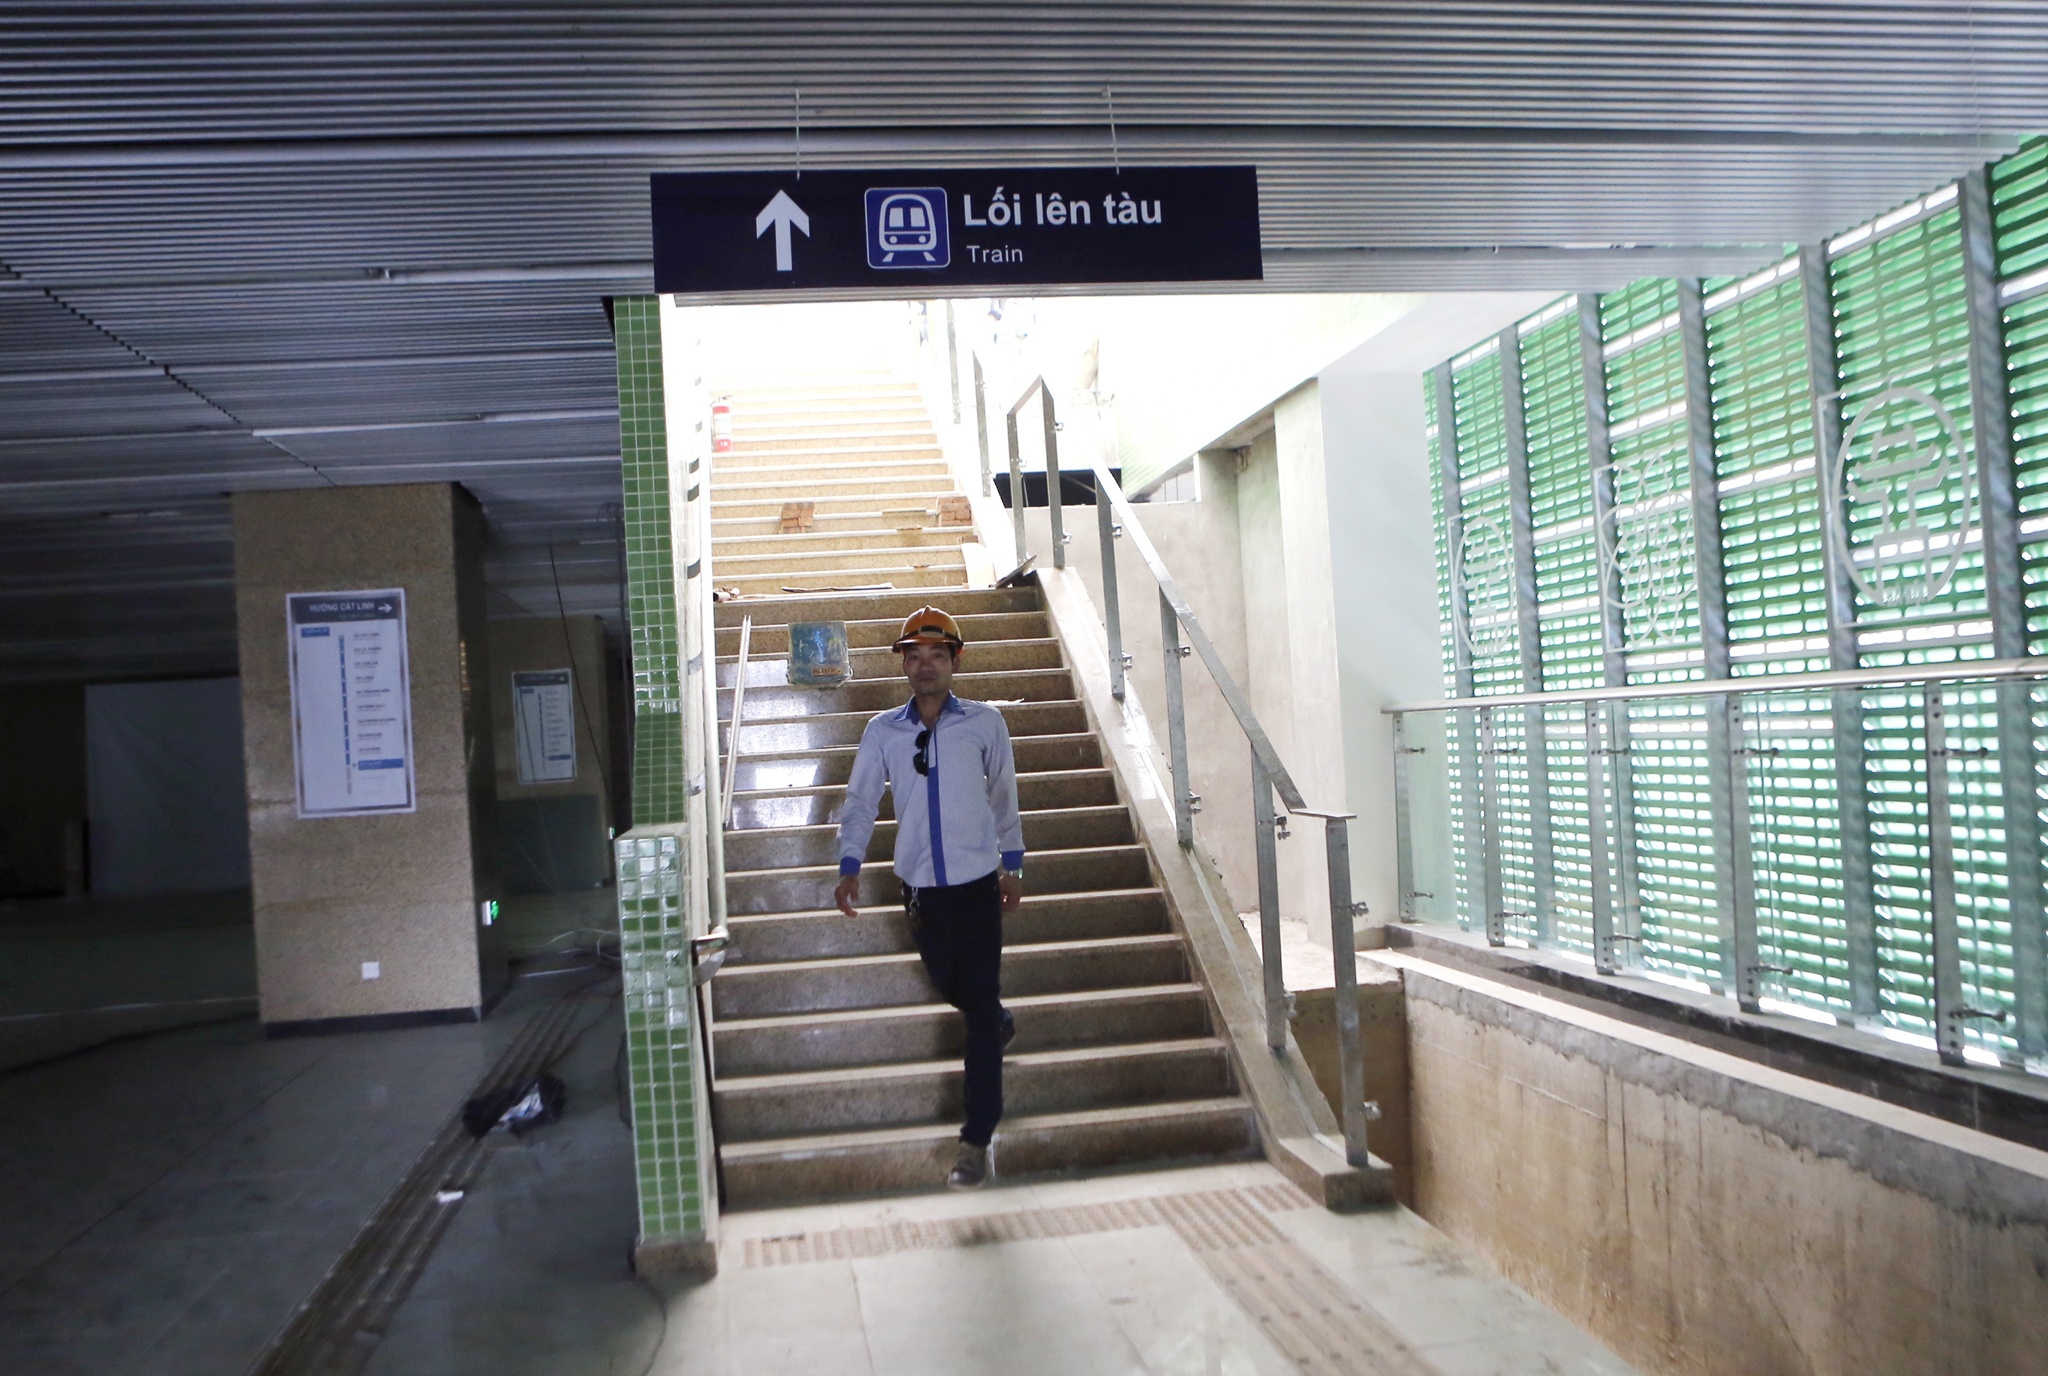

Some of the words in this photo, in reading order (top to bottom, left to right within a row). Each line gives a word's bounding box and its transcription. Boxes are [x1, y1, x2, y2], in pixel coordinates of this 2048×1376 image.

[963, 186, 1022, 226] Lối
[1035, 192, 1091, 225] lên
[1103, 192, 1162, 224] tàu
[966, 245, 1023, 263] Train
[357, 602, 375, 610] LINH
